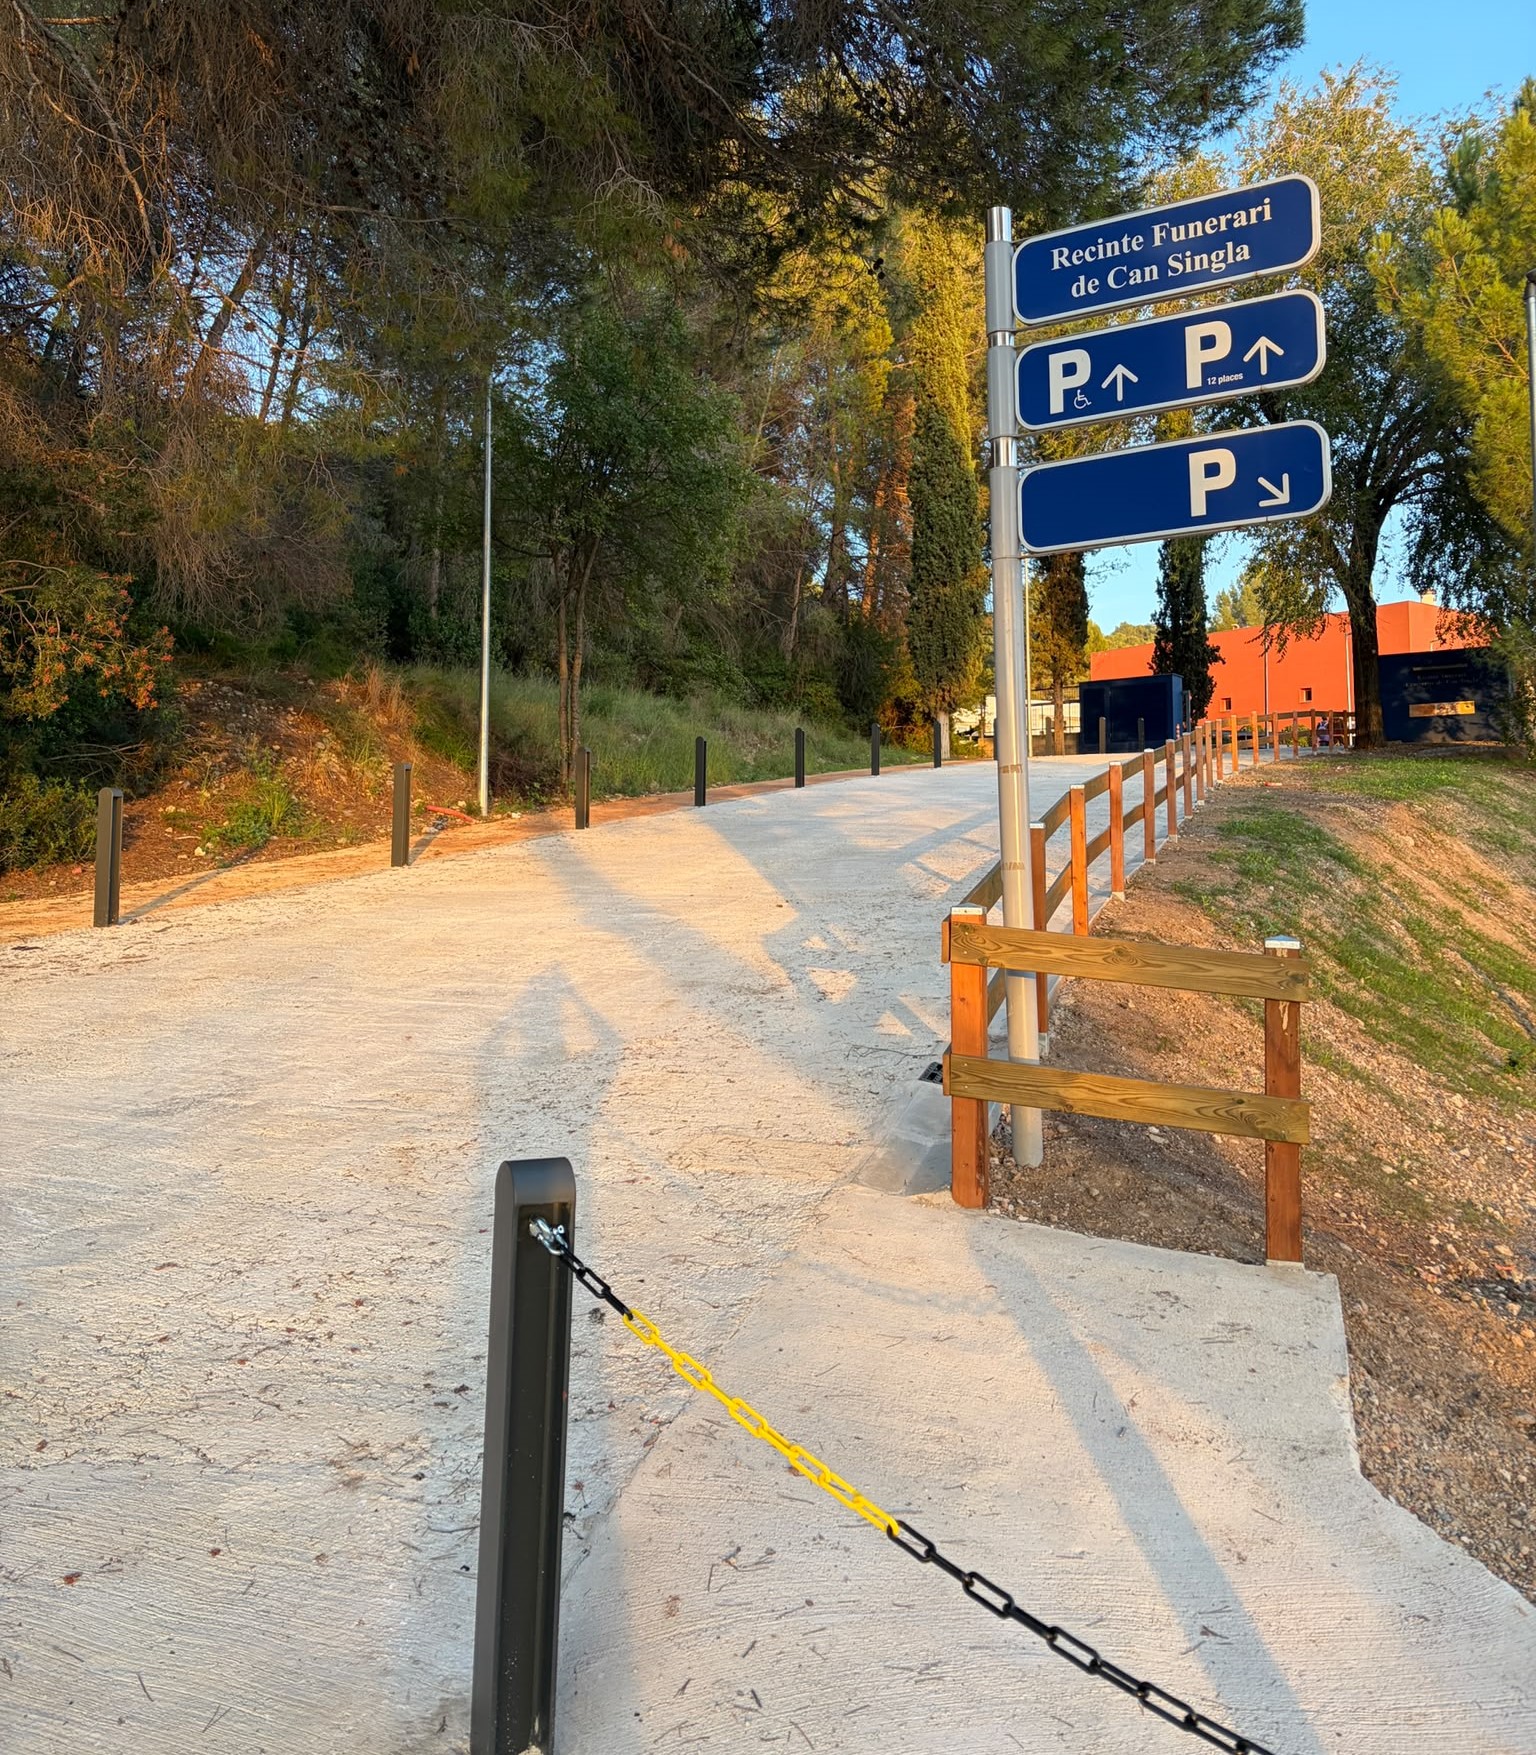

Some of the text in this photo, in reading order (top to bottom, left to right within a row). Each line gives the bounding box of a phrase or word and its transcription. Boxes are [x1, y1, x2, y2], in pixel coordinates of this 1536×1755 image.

[1051, 197, 1272, 271] Recinte Funerari
[1071, 239, 1251, 299] de Can Singla
[1048, 348, 1092, 415] P
[1184, 320, 1232, 389] P
[1207, 372, 1244, 385] 12 places
[1188, 448, 1237, 517] P
